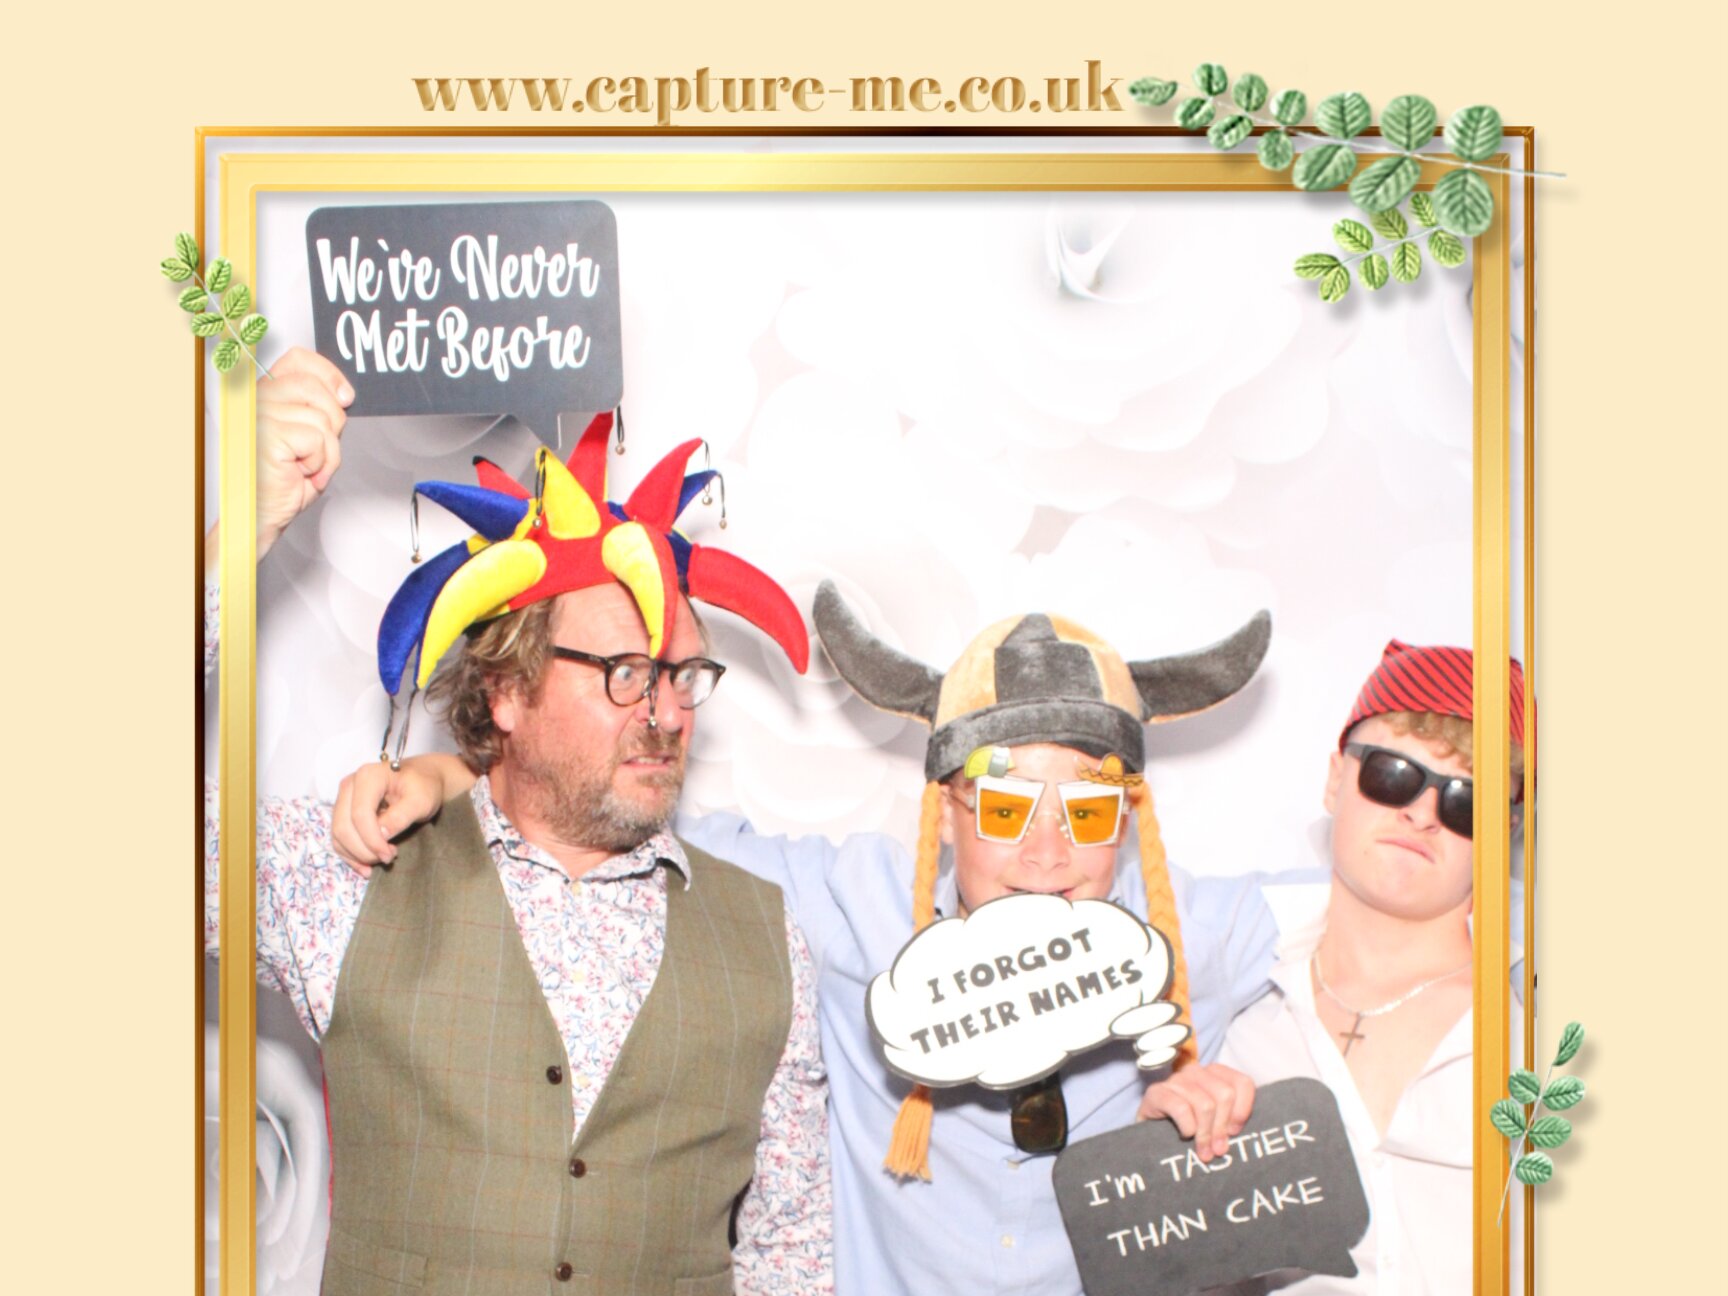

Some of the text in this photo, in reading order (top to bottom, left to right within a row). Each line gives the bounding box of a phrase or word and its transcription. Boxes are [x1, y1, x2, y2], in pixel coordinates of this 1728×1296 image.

[450, 234, 600, 302] Never
[336, 306, 591, 382] Met Before
[927, 927, 1093, 1005] I FORGOT
[909, 958, 1144, 1055] THEIR NAMES
[1084, 1172, 1146, 1207] I'm
[1106, 1176, 1324, 1257] THAN CAKE
